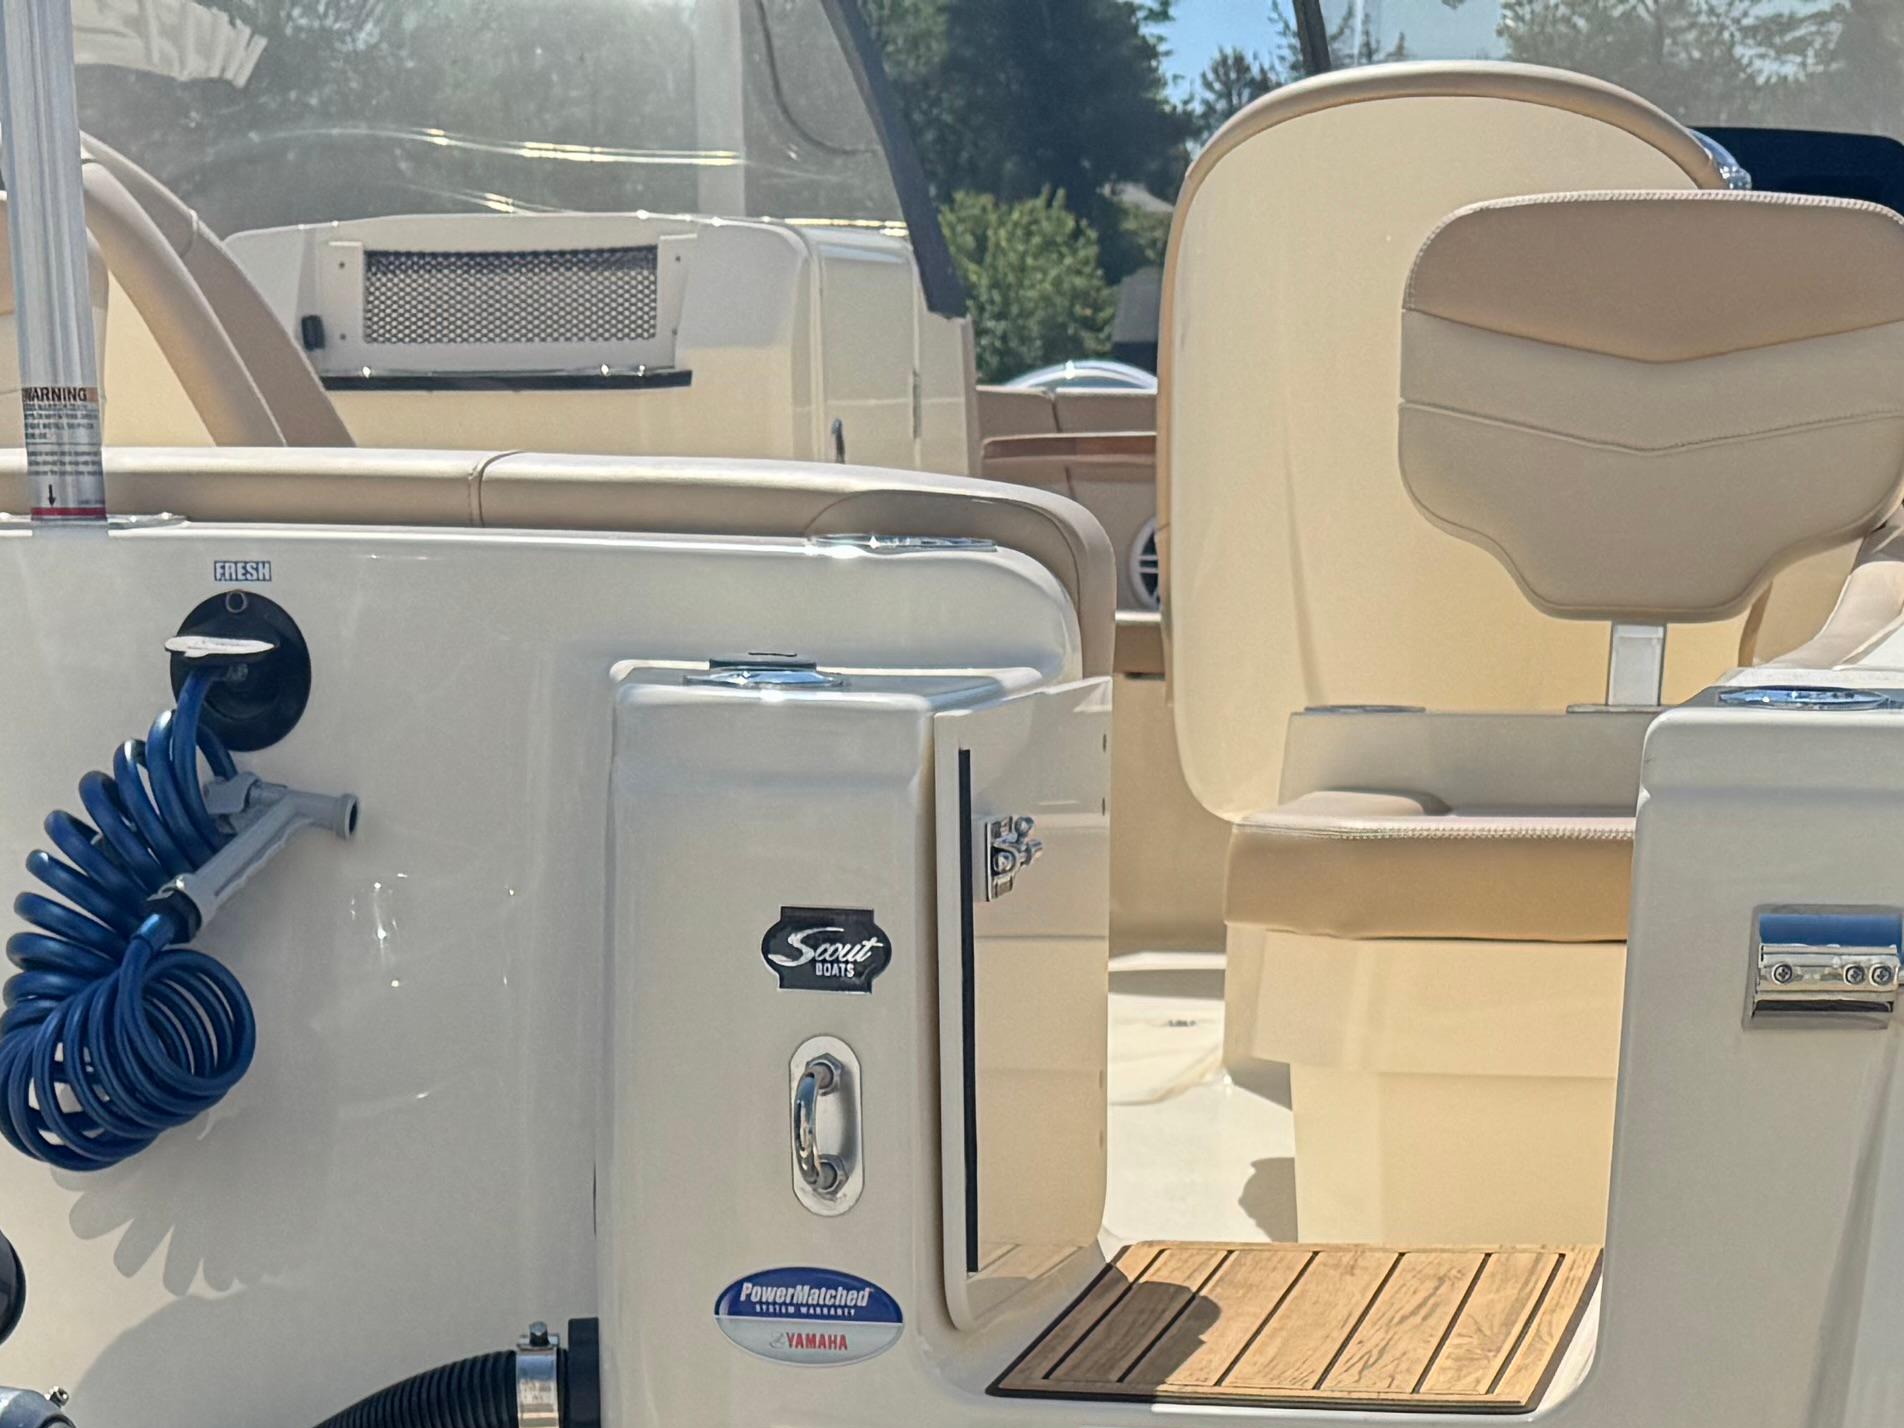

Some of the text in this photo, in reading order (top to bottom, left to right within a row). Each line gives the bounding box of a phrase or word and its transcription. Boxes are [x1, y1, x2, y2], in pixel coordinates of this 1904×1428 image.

[215, 562, 271, 581] FRESH
[767, 926, 884, 967] Scout
[815, 962, 855, 978] BOATS
[739, 1282, 872, 1307] PowerMatched
[755, 1303, 856, 1317] SYSTEM WARRANTY
[785, 1331, 848, 1351] YAMAHA
